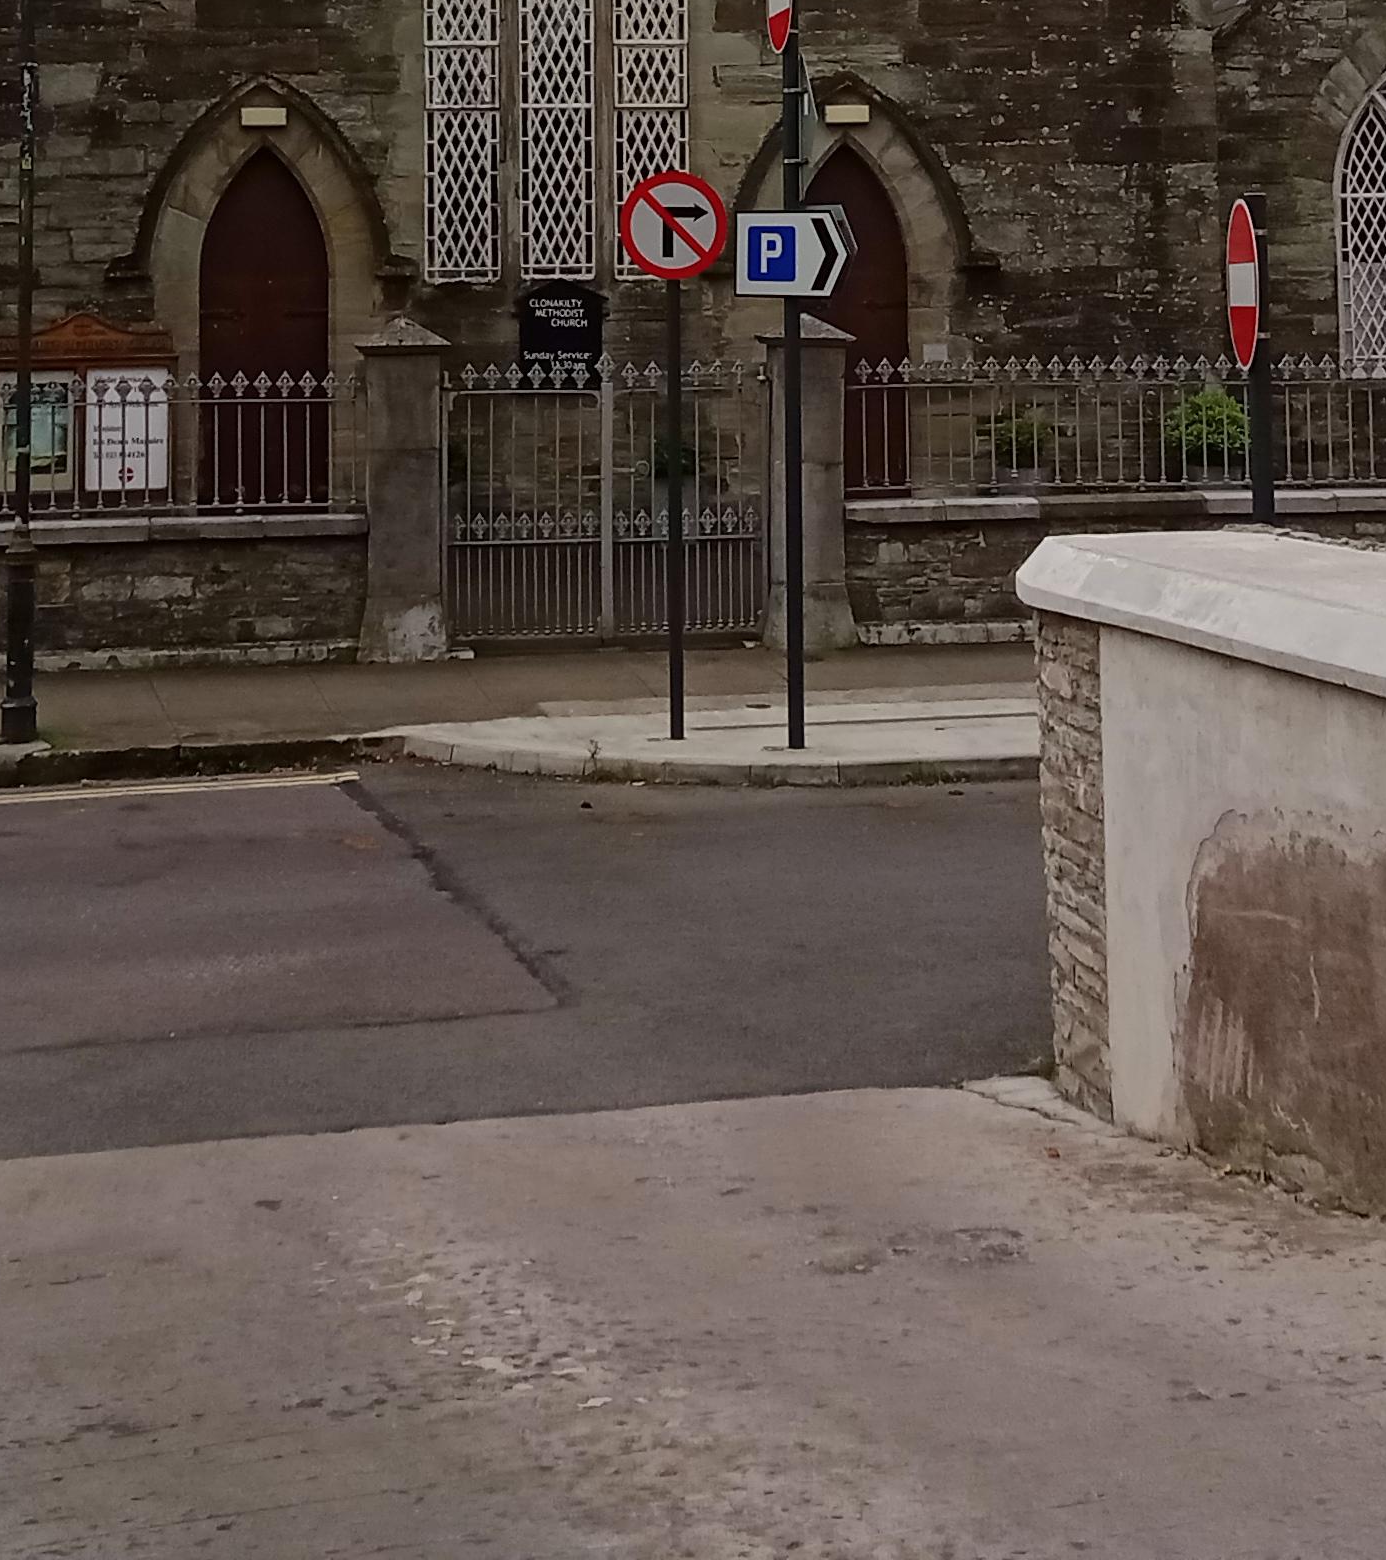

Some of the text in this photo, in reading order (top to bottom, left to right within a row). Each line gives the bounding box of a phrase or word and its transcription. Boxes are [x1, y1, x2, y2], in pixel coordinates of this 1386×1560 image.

[760, 232, 783, 274] P
[529, 298, 583, 308] CLONAKILTY
[535, 308, 585, 318] METHODIST
[551, 318, 588, 328] CHURCH
[524, 350, 554, 361] Sunday
